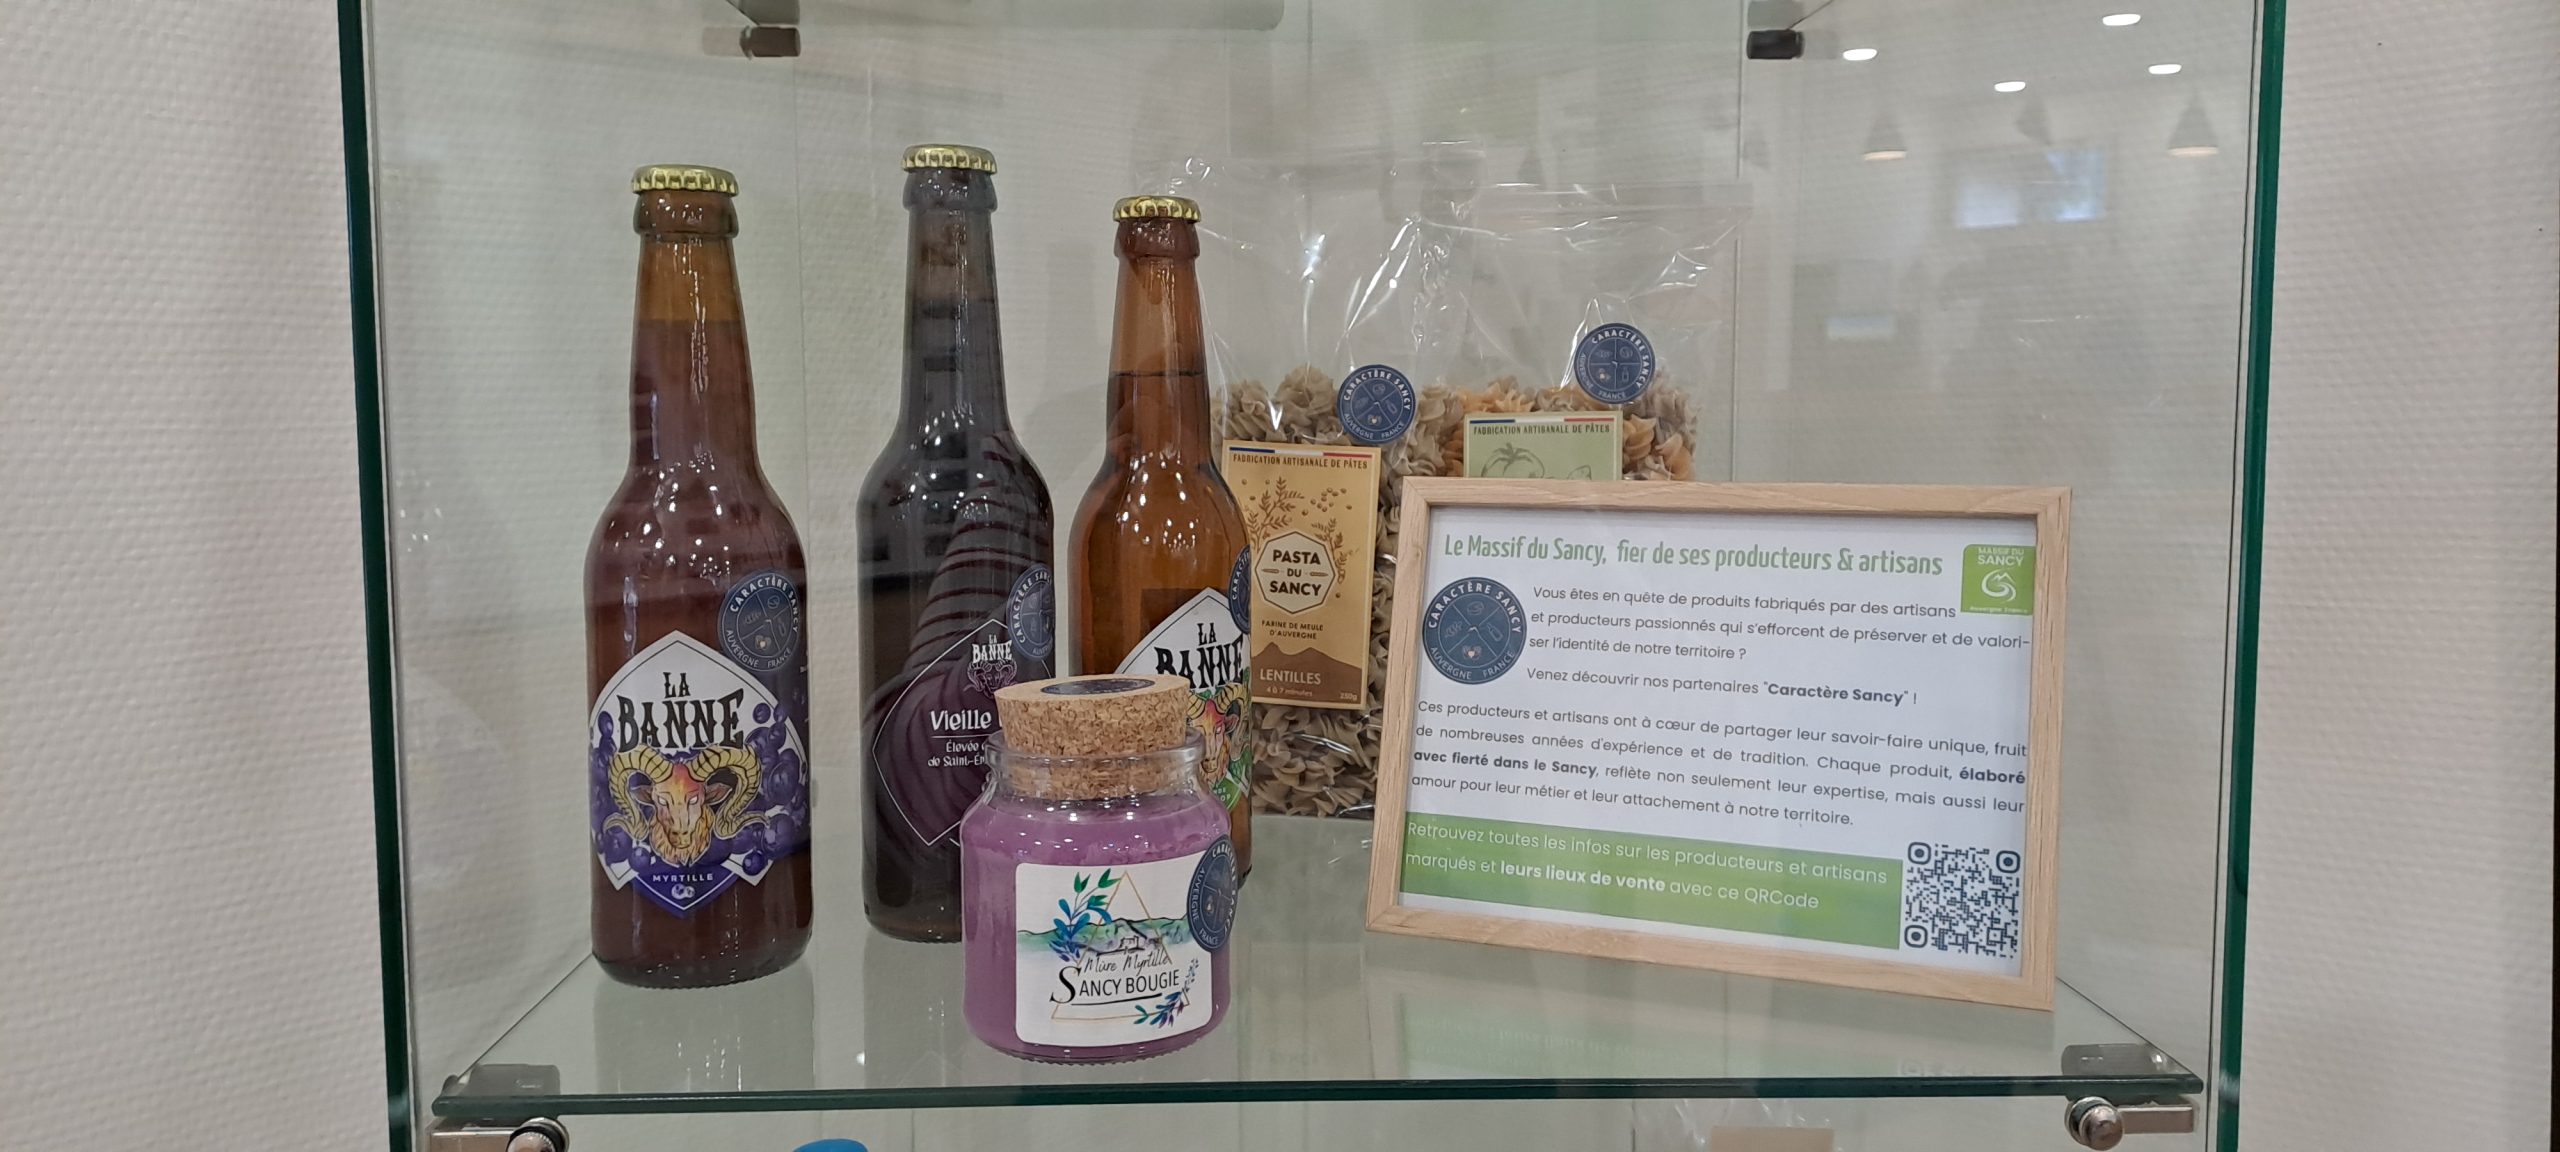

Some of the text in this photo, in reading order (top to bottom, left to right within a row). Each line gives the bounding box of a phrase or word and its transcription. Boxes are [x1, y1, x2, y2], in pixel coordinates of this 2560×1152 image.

[1636, 354, 1650, 388] SANCY
[1394, 378, 1411, 410] SANCY
[1473, 422, 1610, 435] FABRICATION ARTISANALE DE PÂTES
[1233, 453, 1368, 469] FABRICATION ARTISANALE DE PÂTES
[1273, 549, 1321, 565] PASTA
[1445, 534, 1943, 576] Le Massif du Sancy, fier de ses producteurs & artisans
[1977, 555, 2024, 566] SANCY
[1270, 580, 1321, 596] SANCY
[1287, 568, 1302, 577] DU
[730, 575, 799, 632] CARACTÈRE SANCY
[1428, 581, 1521, 633] CARACTÈRE SANCY
[1533, 586, 1956, 618] Vous êtes en quête de produits fabriqués par des artisans
[989, 634, 998, 644] LA
[1197, 623, 1217, 646] LA
[1262, 620, 1286, 628] FARINE
[1300, 623, 1323, 631] MEULE
[1269, 630, 1316, 639] D'AUVERGNE
[1531, 611, 2030, 649] et producteurs passionnés qui s'efforcent de préserver et de valori-
[726, 629, 791, 668] AUVERGNE FRANCE
[972, 640, 1012, 663] BANNE
[1154, 633, 1243, 689] BANNE
[1431, 647, 1515, 680] AUVERGNE FRANCE
[1529, 637, 1735, 659] ser l'identité de notre territoire
[663, 672, 690, 699] LA
[1260, 669, 1321, 685] LENTILLES
[1527, 668, 1909, 707] Venez découvrir nos partenaires "Caractère Sancy"
[617, 689, 744, 753] BANNE
[930, 709, 992, 731] Vieille
[1418, 700, 2028, 757] Ces producteurs et artisans ont à cœur de partager leur savoir-faire unique, fruit
[927, 756, 941, 767] de
[946, 739, 979, 752] Élevée
[1415, 725, 2025, 784] de nombreuses années d'expérience et de tradition. Chaque produit, élaboré
[1413, 751, 2025, 813] avec fierté dans le Sancy, reflète non seulement leur expertise, mais aussi leur
[1411, 776, 1853, 823] amour pour leur métier et leur attachement à notre territoire.
[1408, 822, 1887, 884] Retrouvez toutes les infos sur les producteurs et artisans
[652, 872, 714, 883] MYRTILLE
[1191, 867, 1205, 920] AUVERGNE
[1406, 852, 1819, 909] marqués et leurs lieux de vente avec ce QRCode
[1084, 949, 1171, 976] Mûre Myrtille
[1049, 966, 1180, 1003] SANCY BOUGIE
